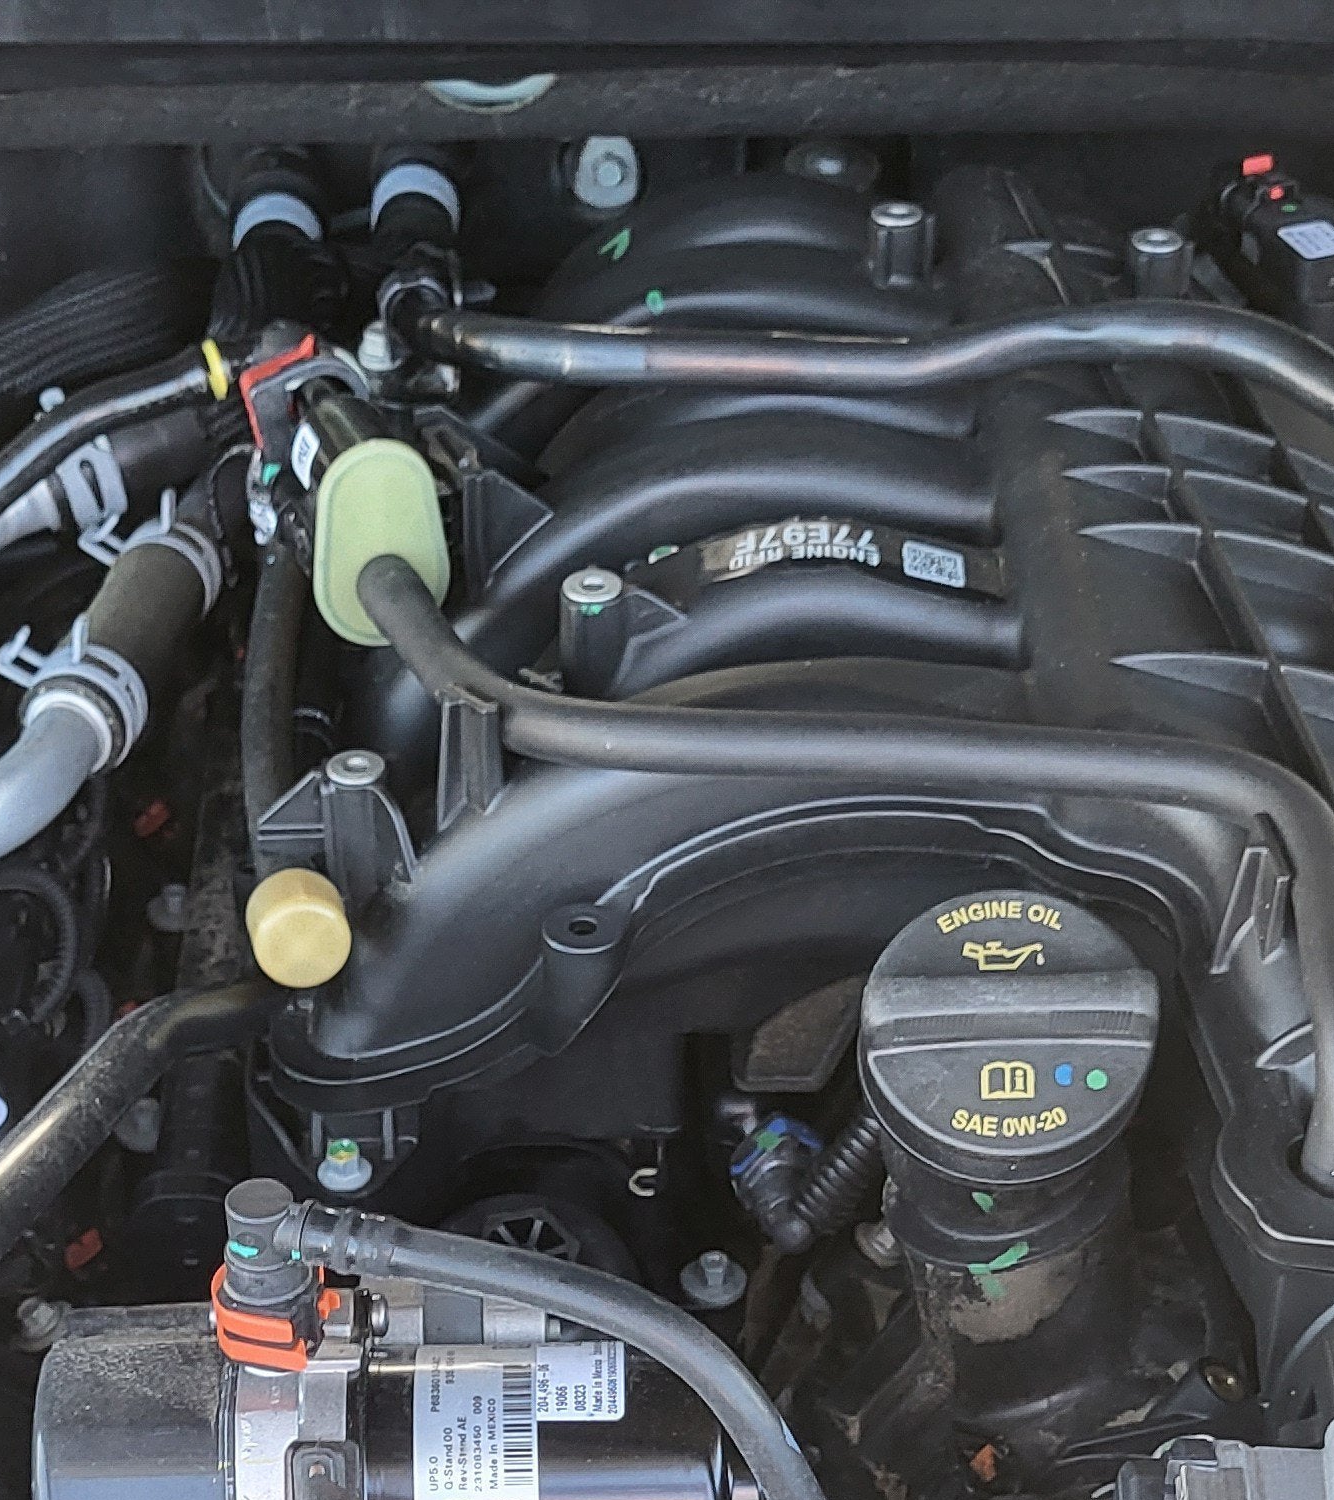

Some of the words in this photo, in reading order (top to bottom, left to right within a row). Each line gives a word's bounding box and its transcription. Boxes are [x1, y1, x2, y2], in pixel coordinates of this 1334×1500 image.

[790, 544, 881, 568] ENGINE
[936, 900, 1022, 934] ENGINE
[1027, 903, 1062, 931] OIL
[951, 1108, 999, 1138] SAE
[1002, 1105, 1068, 1138] 0W-20
[457, 1416, 468, 1431] AE
[487, 1397, 497, 1441] MEXICO
[489, 1458, 499, 1490] Made
